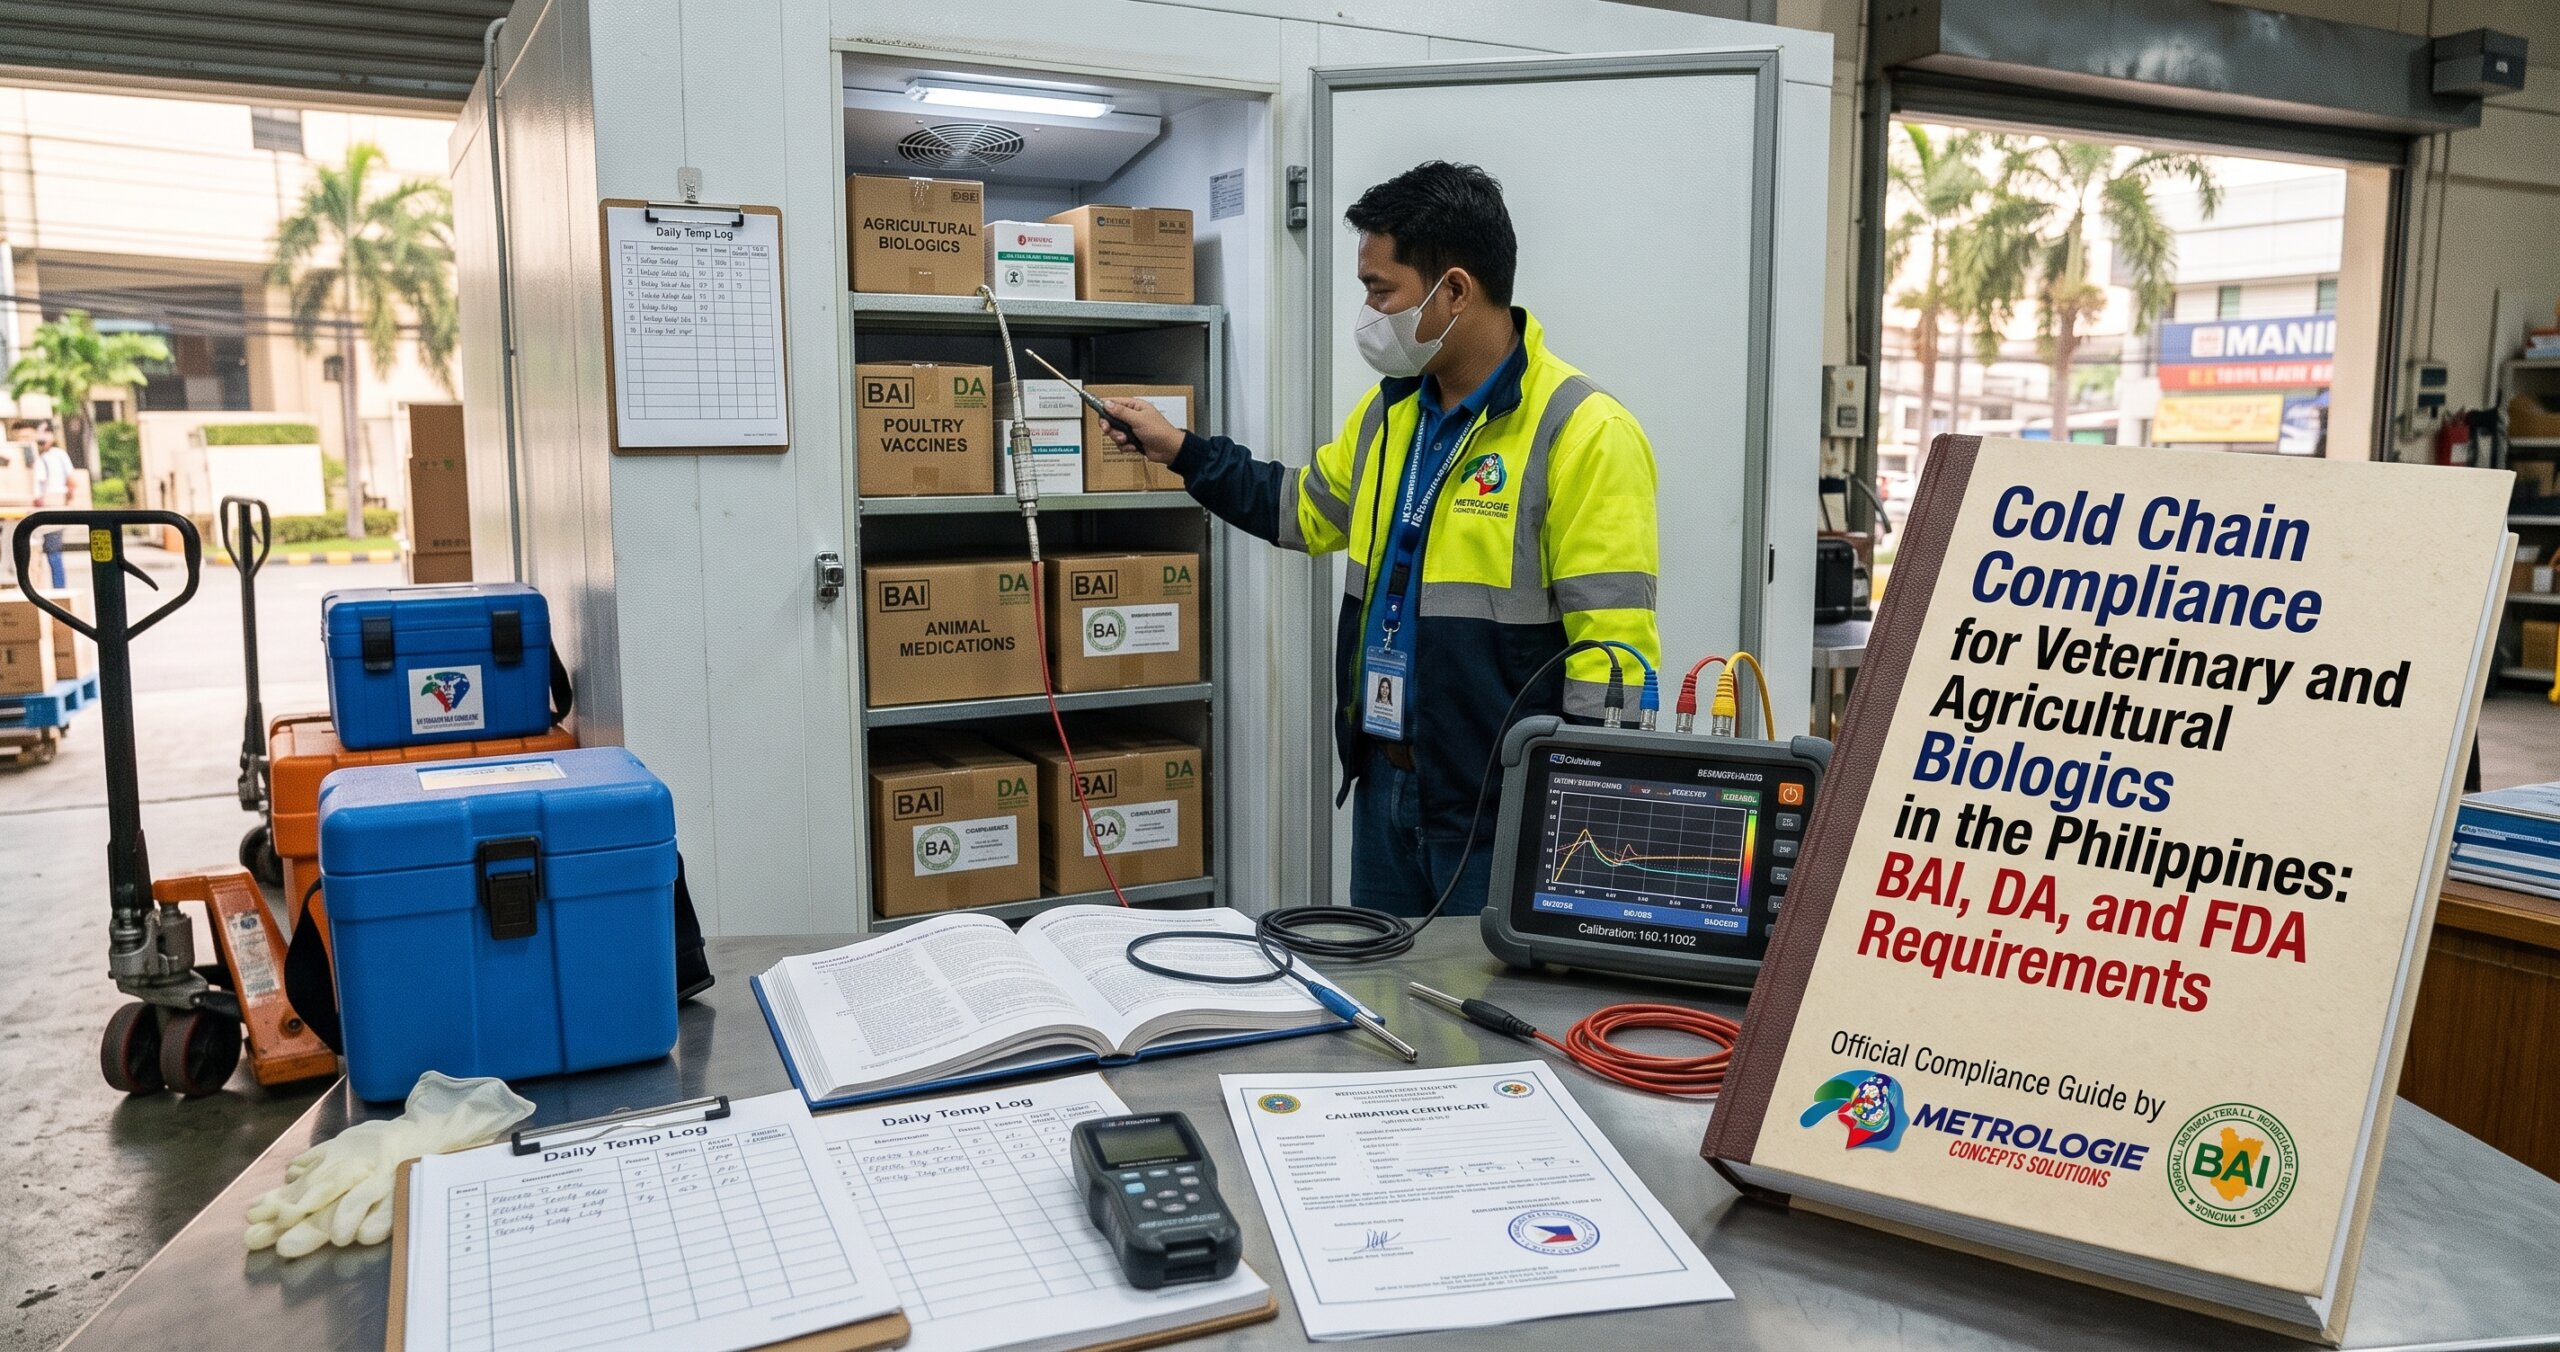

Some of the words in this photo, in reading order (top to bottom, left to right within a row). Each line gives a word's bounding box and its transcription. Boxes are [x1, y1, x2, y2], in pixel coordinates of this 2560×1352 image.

[656, 226, 681, 239] Daily
[684, 228, 712, 240] Temp
[714, 229, 734, 241] Log
[863, 217, 977, 237] AGRICULTURAL
[878, 236, 960, 253] BIOLOGICS
[867, 381, 910, 404] BAI
[953, 376, 986, 397] DA
[883, 418, 964, 434] POULTRY
[880, 436, 968, 452] VACCINES
[1453, 498, 1510, 512] METROLOGIE
[1992, 485, 2124, 546] Cold
[2138, 496, 2310, 562] Chain
[999, 573, 1030, 592] DA
[1074, 575, 1113, 596] BAI
[1162, 565, 1192, 584] DA
[885, 585, 926, 607] BAI
[1971, 550, 2322, 633] Compliance
[925, 619, 991, 636] ANIMAL
[900, 636, 1016, 657] MEDICATIONS
[1950, 616, 2022, 666] for
[2036, 623, 2295, 706] Veterinary
[2305, 660, 2411, 708] and
[1930, 674, 2234, 751] Agricultural
[1165, 759, 1194, 778] DA
[1912, 730, 2175, 812] Biologics
[997, 777, 1029, 797] DA
[1074, 773, 1113, 796] BAI
[897, 791, 940, 815] BAI
[925, 839, 952, 857] BA
[1893, 794, 1941, 843] in
[1954, 803, 2034, 856] the
[2045, 814, 2354, 903] Philippines:
[1874, 851, 1972, 920] BAI,
[1988, 868, 2072, 935] DA,
[2085, 894, 2190, 943] and
[2199, 906, 2307, 964] FDA
[1578, 922, 1637, 941] Calibration:
[1639, 930, 1697, 946] 160.11002
[1856, 909, 2212, 1013] Requirements
[1830, 1030, 1909, 1067] Official
[1914, 1047, 2051, 1095] Compliance
[2057, 1073, 2128, 1110] Guide
[2134, 1089, 2166, 1123] by
[882, 1114, 931, 1127] Daily
[937, 1104, 990, 1118] Temp
[996, 1096, 1034, 1110] Log
[1325, 1107, 1409, 1120] CALIBRATION
[1412, 1102, 1490, 1115] CERTIFICATE
[544, 1144, 597, 1163] Daily
[602, 1133, 662, 1151] Temp
[667, 1125, 709, 1139] Log
[1913, 1103, 2150, 1172] METROLOGIE
[1949, 1139, 2025, 1171] CONCEPTS
[2026, 1156, 2111, 1189] SOLUTIONS
[2192, 1142, 2271, 1189] BAI
